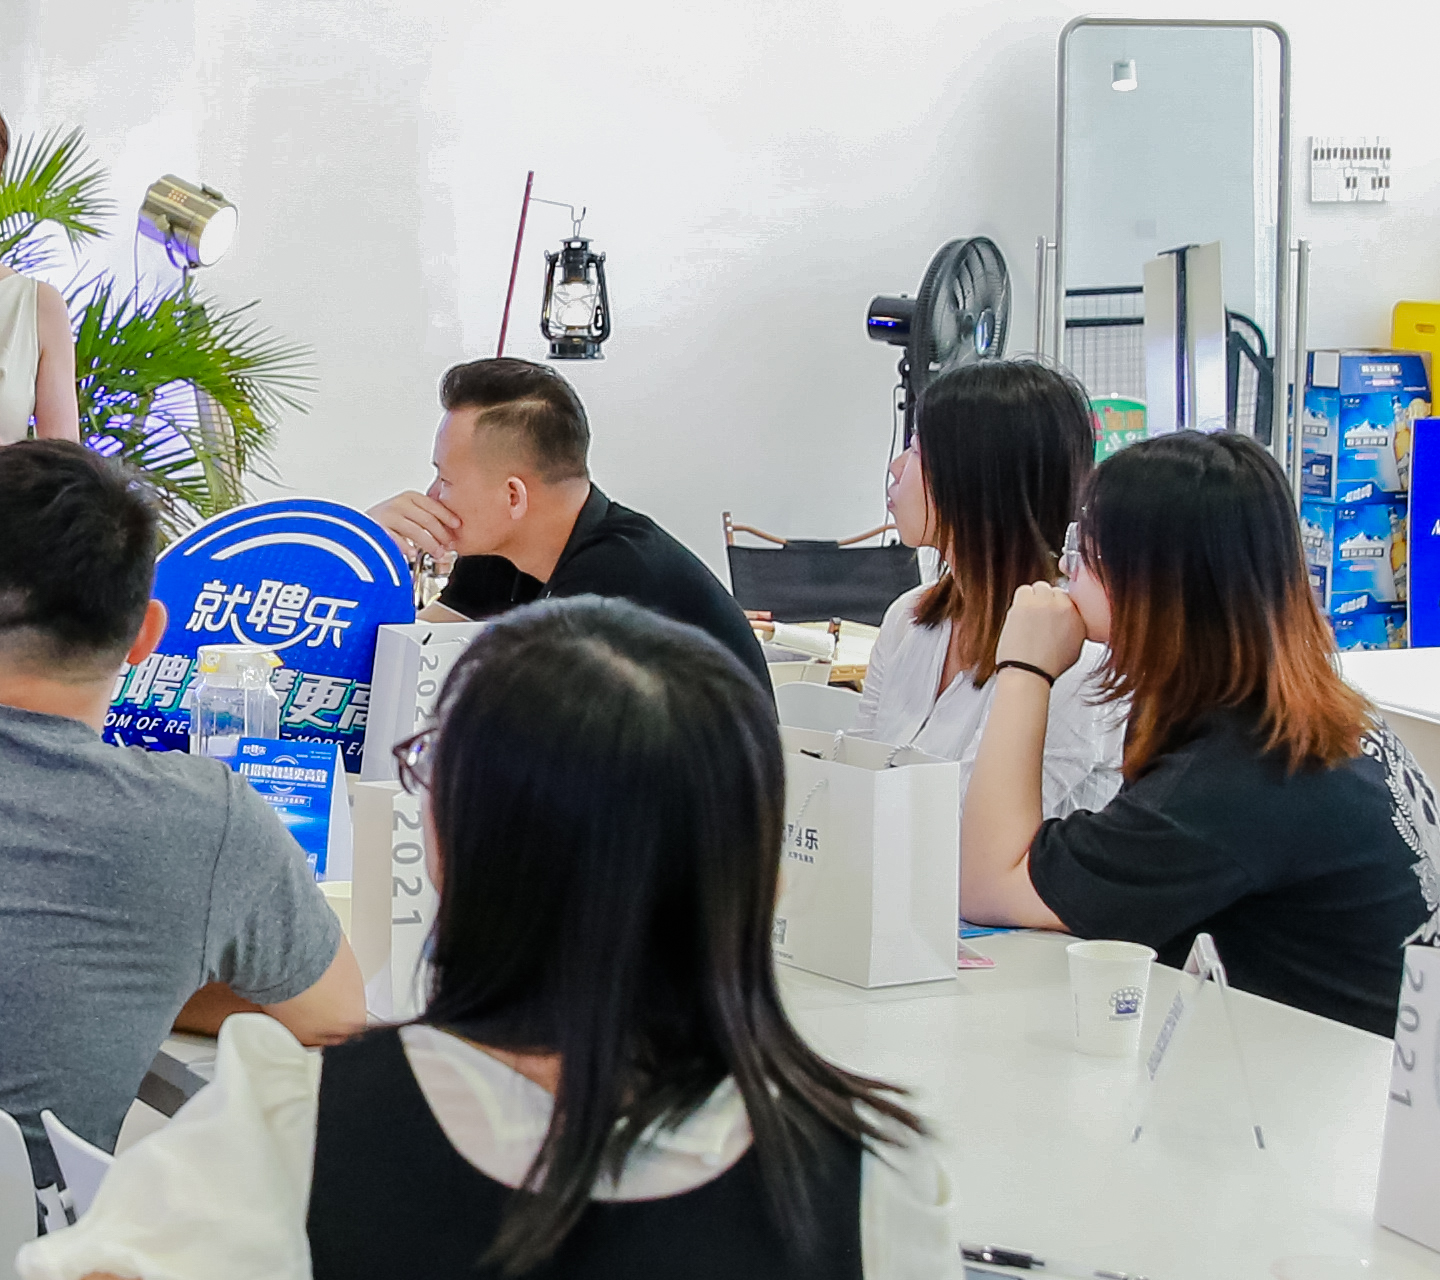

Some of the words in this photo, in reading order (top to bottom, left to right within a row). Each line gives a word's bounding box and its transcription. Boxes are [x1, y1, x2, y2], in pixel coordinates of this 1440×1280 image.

[186, 579, 359, 650] 就聘乐
[136, 716, 159, 731] OF
[392, 810, 423, 924] 2021
[1391, 966, 1424, 1108] 2021
